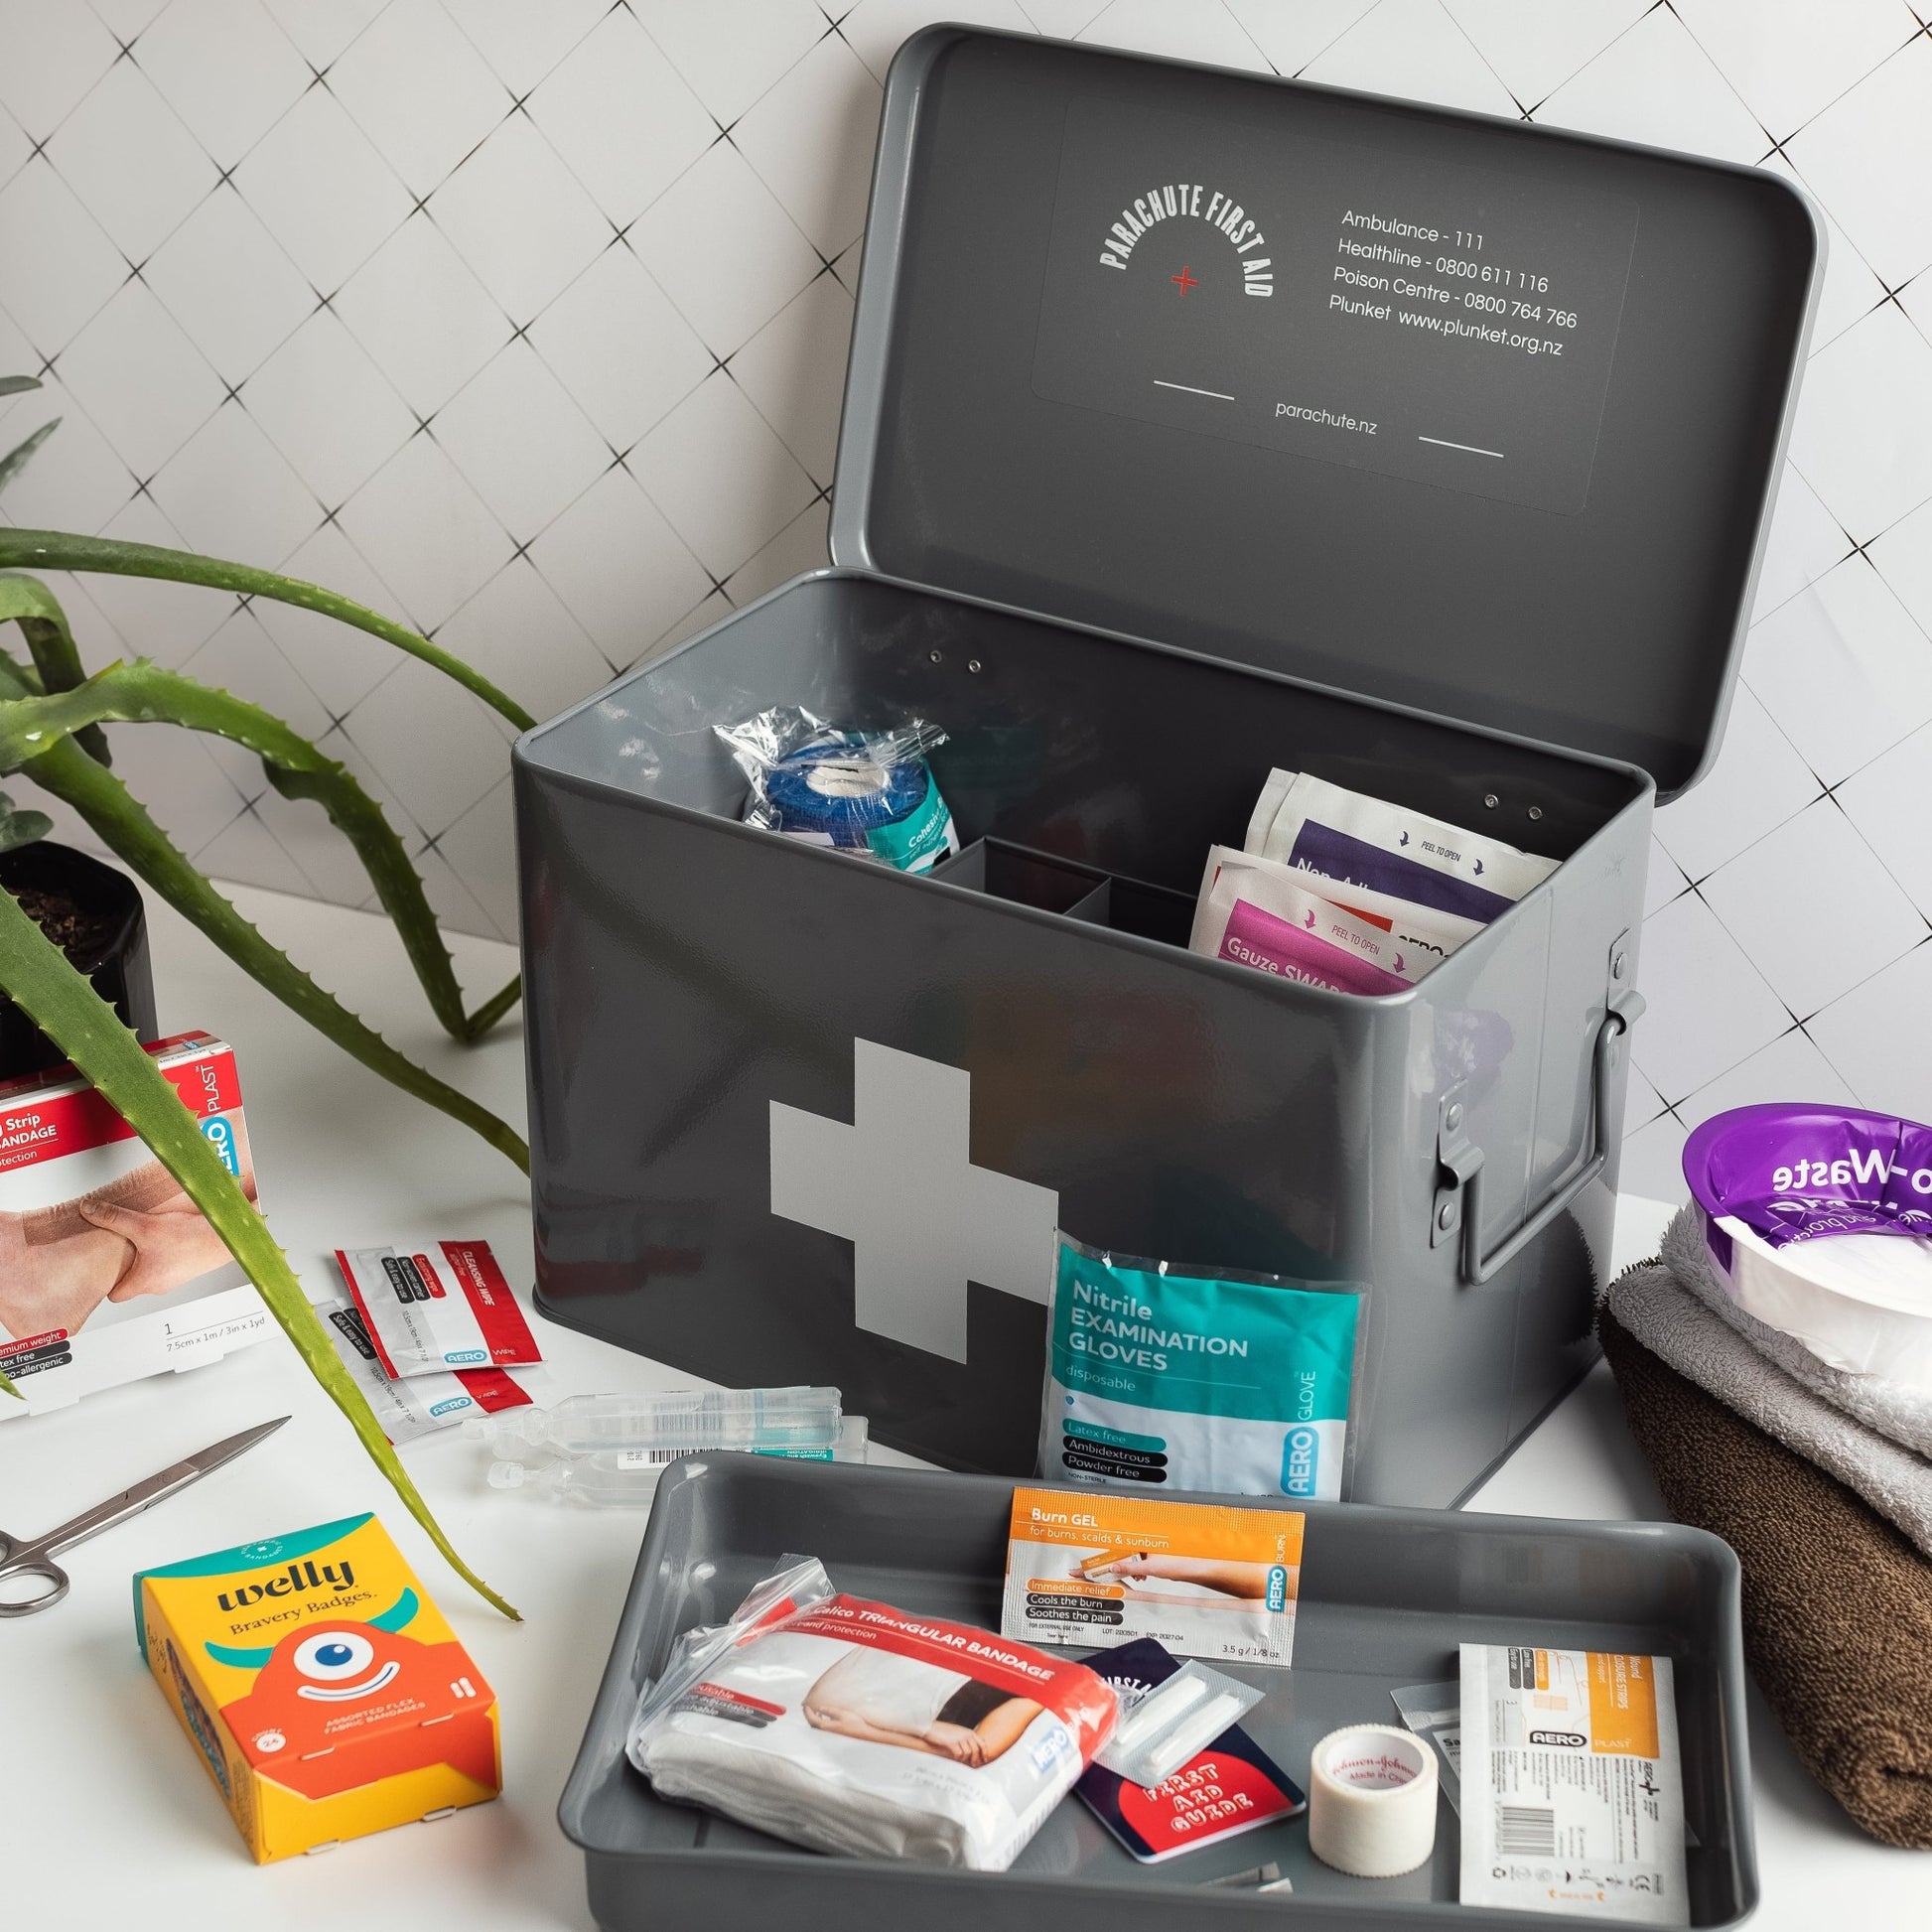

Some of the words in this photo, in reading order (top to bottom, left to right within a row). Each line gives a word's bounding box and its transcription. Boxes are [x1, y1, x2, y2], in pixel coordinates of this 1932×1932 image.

[1099, 184, 1203, 270] PARACHUTE
[1204, 191, 1265, 254] FIRST
[1242, 258, 1274, 297] AID
[1341, 209, 1439, 241] Ambulance
[1455, 230, 1483, 250] 111
[1338, 237, 1422, 268] Healthline
[1436, 256, 1477, 279] 0800
[1480, 266, 1511, 286] 611
[1519, 272, 1549, 293] 116
[1333, 266, 1389, 291] Poison
[1393, 278, 1449, 303] Centre
[1464, 292, 1506, 314] 0800
[1511, 301, 1541, 321] 764
[1547, 308, 1578, 329] 766
[1329, 294, 1392, 321] Plunket
[1398, 310, 1564, 355] www.plunket.org.nz
[1275, 400, 1378, 435] parachute.nz
[1421, 840, 1437, 853] PEEL
[1437, 845, 1446, 856] TO
[1446, 849, 1461, 862] OPEN
[1331, 924, 1350, 941] PEEL
[1350, 932, 1361, 944] TO
[1361, 937, 1380, 955] OPEN
[1227, 936, 1279, 975] Gauze
[200, 1064, 221, 1112] PLAST
[5, 1113, 41, 1131] Strip
[0, 1125, 57, 1149] ANDAGE
[462, 1251, 486, 1288] CLEANSING
[479, 1287, 494, 1307] WIPE
[1072, 1279, 1152, 1321] Nitrile
[164, 1323, 173, 1335] 1
[166, 1339, 195, 1352] 7.5cm
[249, 1316, 265, 1328] 1yd
[333, 1313, 345, 1327] Safe
[1069, 1307, 1248, 1358] EXAMINATION
[31, 1331, 62, 1344] weight
[1068, 1331, 1168, 1372] GLOVES
[16, 1352, 36, 1363] free
[447, 1352, 485, 1362] AERO
[1065, 1363, 1136, 1392] disposable
[433, 1397, 471, 1416] AERO
[1298, 1370, 1316, 1421] GLOVE
[1068, 1422, 1099, 1438] Latex
[1103, 1430, 1126, 1444] free
[1068, 1439, 1151, 1463] Ambidextrous
[1287, 1431, 1313, 1492] AERO
[1068, 1454, 1113, 1473] Powder
[1116, 1464, 1140, 1478] free
[1031, 1507, 1067, 1524] Burn
[1071, 1513, 1099, 1527] GEL
[1030, 1525, 1043, 1536] for
[1081, 1532, 1112, 1544] scalds
[1115, 1534, 1123, 1545] &
[1126, 1537, 1170, 1549] sunburn
[216, 1561, 355, 1611] welly
[1032, 1581, 1083, 1594] Immediate
[1084, 1587, 1111, 1596] relief
[1269, 1569, 1284, 1610] AERO
[1031, 1593, 1058, 1604] Cools
[1060, 1595, 1078, 1606] the
[1079, 1596, 1103, 1609] burn
[229, 1607, 302, 1635] Bravery
[824, 1620, 878, 1640] protection
[1030, 1608, 1070, 1619] Soothes
[1072, 1609, 1089, 1621] the
[1091, 1611, 1112, 1624] pain
[813, 1605, 855, 1618] Calico
[858, 1609, 969, 1649] TRIANGULAR
[966, 1640, 1055, 1682] BANDAGE
[1222, 1645, 1236, 1654] 3.5
[1238, 1647, 1244, 1656] g
[1253, 1648, 1268, 1657] 1/8
[1616, 1683, 1629, 1710] STRIPS
[324, 1719, 365, 1735] FABRIC
[365, 1701, 427, 1724] BANDAGES
[326, 1705, 385, 1727] ASSORTED
[385, 1697, 415, 1711] FLEX
[1532, 1731, 1584, 1746] AERO
[1143, 1762, 1219, 1802] FIRST
[1170, 1792, 1254, 1833] GUIDE
[1172, 1784, 1224, 1813] AID
